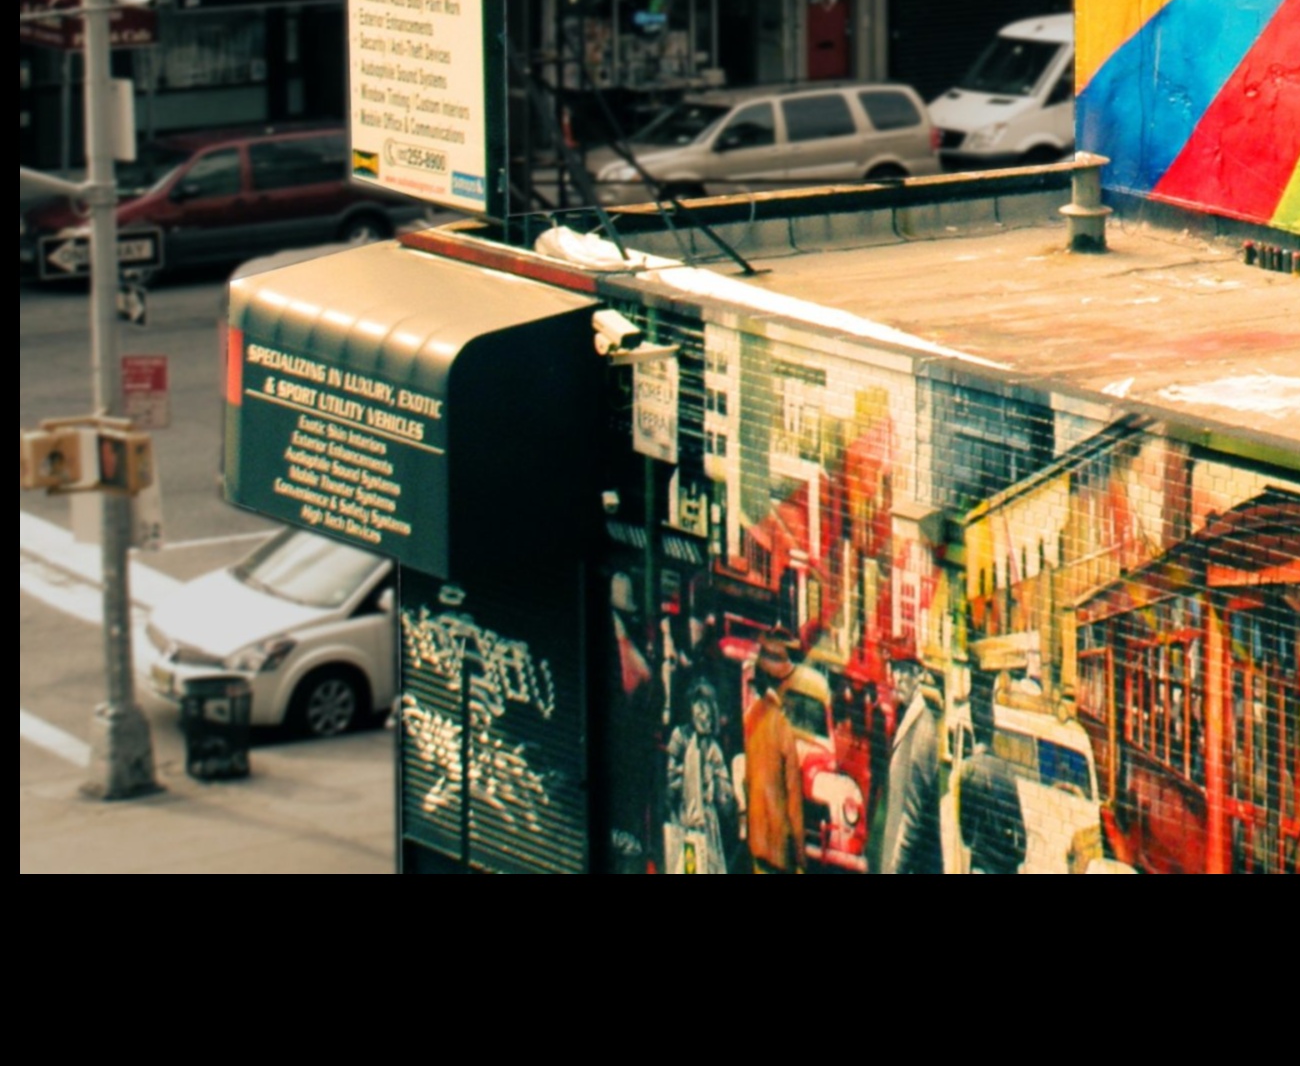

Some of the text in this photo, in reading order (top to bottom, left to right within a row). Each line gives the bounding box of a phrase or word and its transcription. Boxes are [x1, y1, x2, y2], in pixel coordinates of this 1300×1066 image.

[359, 7, 433, 36] Exterior Enhancements
[425, 43, 451, 65] Devices
[396, 64, 418, 84] Sound
[419, 68, 447, 90] Systems
[383, 112, 403, 132] Office
[411, 117, 465, 145] Communications
[247, 344, 442, 420] SPECIALIZING IN LUXURY, EXOTIC
[263, 375, 424, 441] & SPORT UTILITY VEHICLES
[291, 430, 394, 476] Exterior Enhancements
[298, 414, 387, 455] Exotic Skin Interiors
[284, 446, 401, 497] Audiophile Sound Systems
[289, 464, 396, 513] Mobile Theater Systems
[274, 477, 411, 537] Convenience & Safety Systems
[301, 503, 382, 545] High Tech Devices
